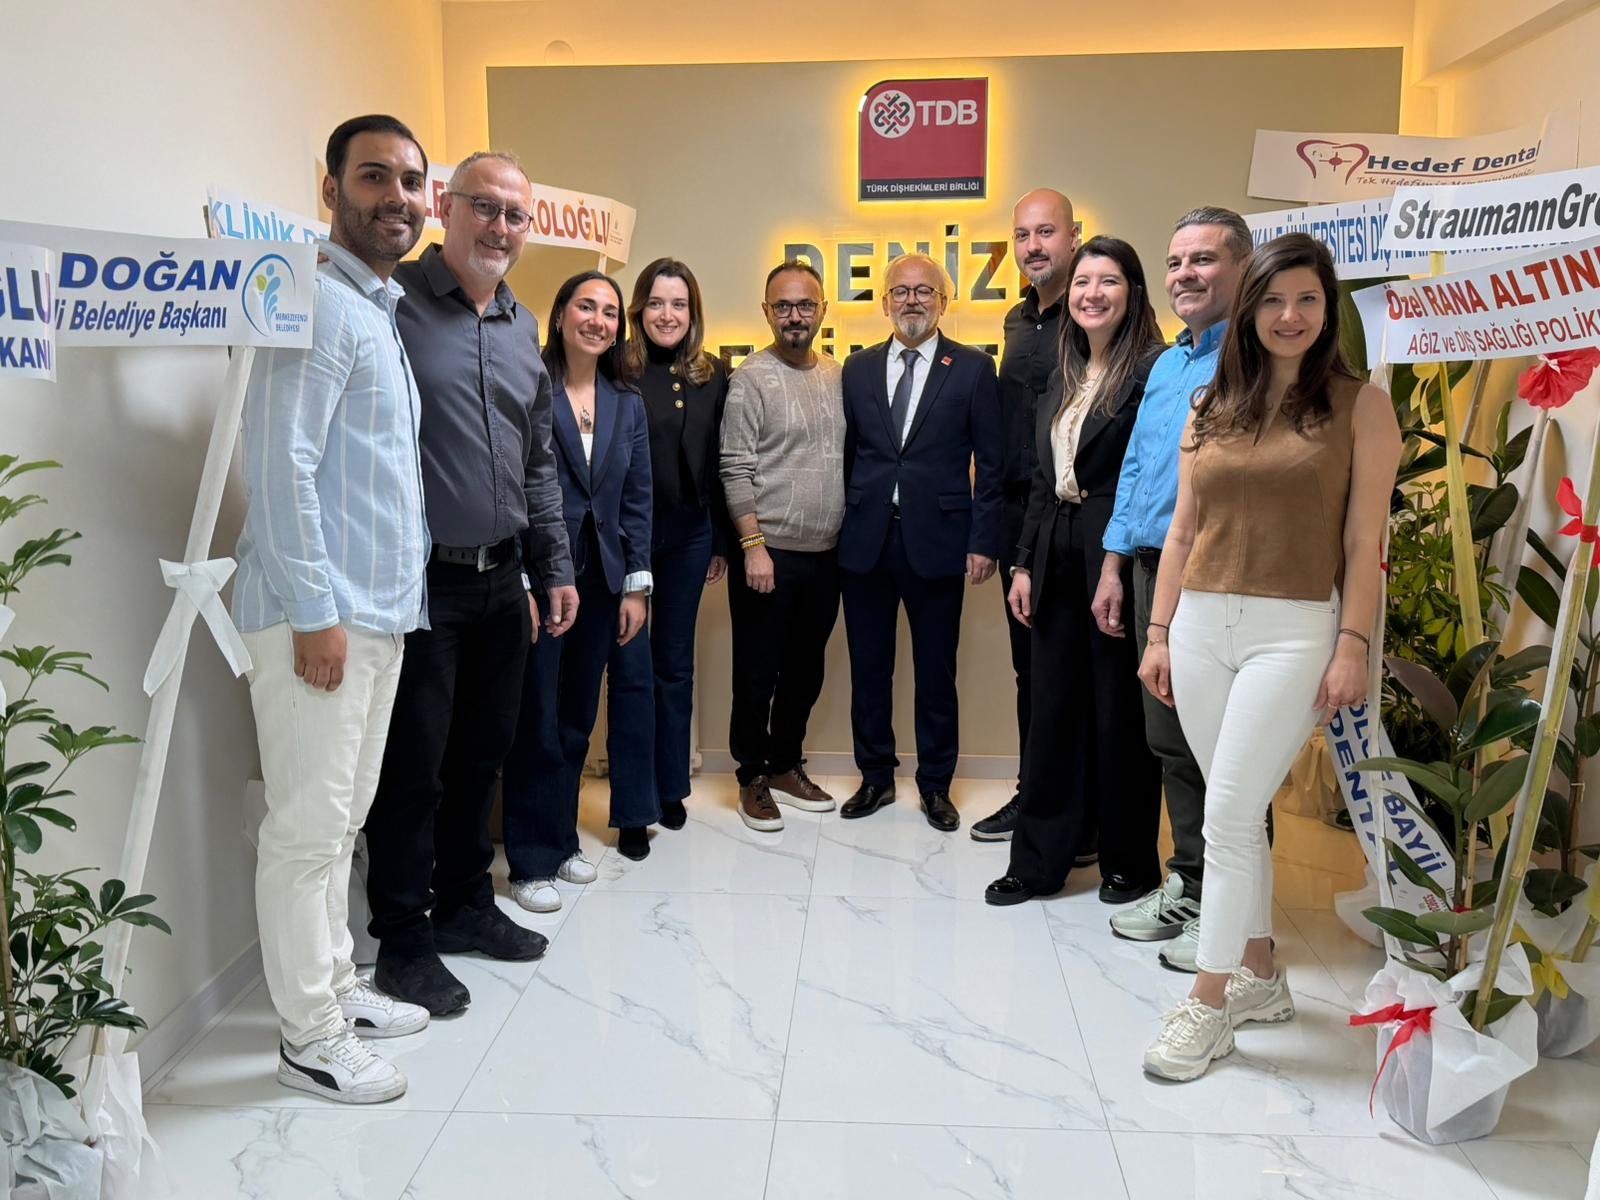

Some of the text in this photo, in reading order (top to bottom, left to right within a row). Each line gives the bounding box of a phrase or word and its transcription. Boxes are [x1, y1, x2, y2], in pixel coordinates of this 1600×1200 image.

[916, 99, 978, 126] TDB
[1367, 140, 1541, 173] Hedef Dental
[866, 181, 979, 194] TÜRK DİŞHEKİMLERİ BİRLİĞİ
[208, 196, 295, 241] KLİNİK
[1394, 183, 1600, 240] StraumannGr
[58, 251, 242, 292] DOĞAN
[1384, 284, 1429, 321] Özel
[1422, 279, 1490, 316] RANA
[1490, 246, 1600, 310] ALTIN
[69, 299, 154, 339] Belediye
[158, 301, 228, 337] Başkanı
[1407, 306, 1600, 357] AĞIZ ve DİŞ SAĞLIĞI POLİK
